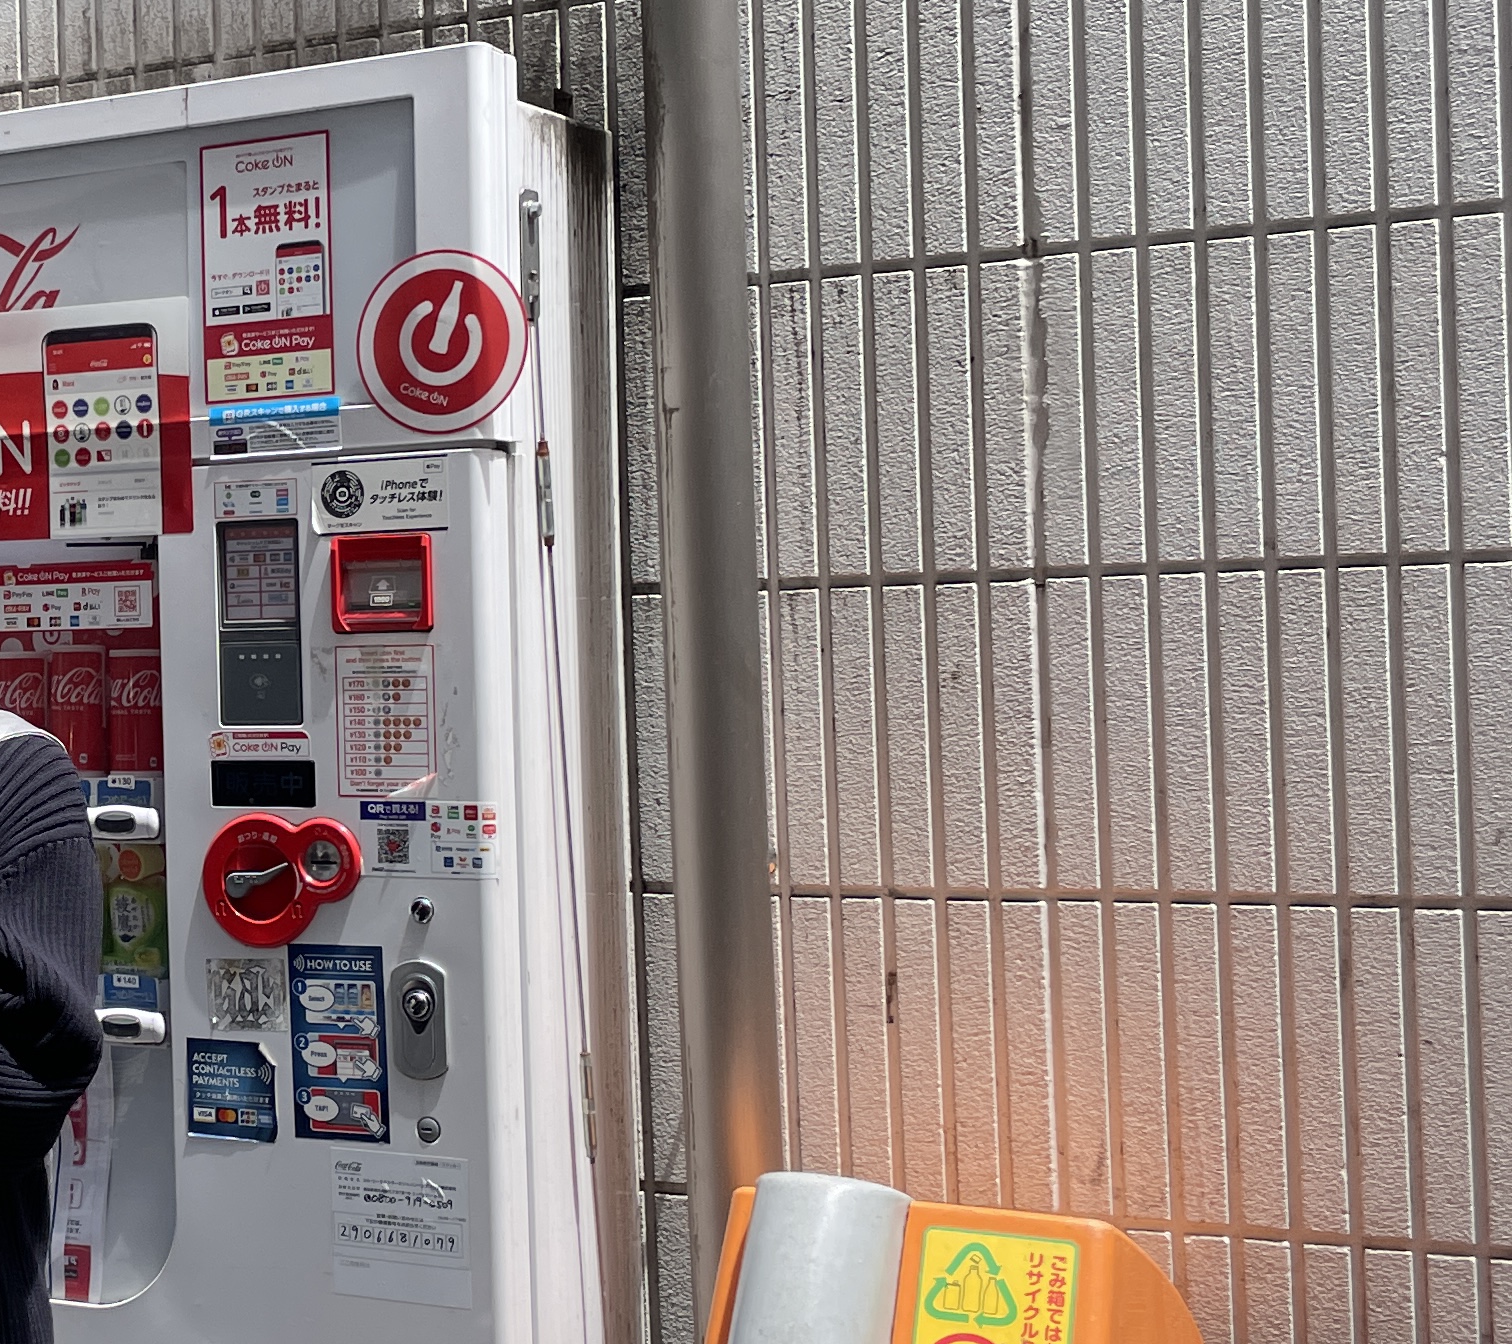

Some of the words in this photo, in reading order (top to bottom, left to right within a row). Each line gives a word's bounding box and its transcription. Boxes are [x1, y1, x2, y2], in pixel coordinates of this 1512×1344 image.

[235, 159, 270, 173] Coke
[272, 153, 294, 169] ON
[252, 180, 320, 198] スタンプたまると
[241, 339, 271, 351] Coke
[272, 336, 291, 348] ON
[291, 336, 315, 349] Pay
[399, 382, 429, 400] Coke
[430, 389, 449, 407] ON
[380, 478, 429, 491] iPhoneで
[369, 490, 443, 505] タッチレス体験!
[17, 572, 38, 582] Coke
[39, 570, 52, 581] ON
[53, 570, 69, 582] Pay
[11, 591, 33, 599] PayPay
[88, 587, 101, 596] Pay
[51, 603, 62, 612] Pay
[349, 680, 365, 688] ¥170
[349, 706, 366, 714] ¥150
[349, 718, 366, 726] ¥140
[350, 730, 366, 738] ¥130
[232, 742, 260, 753] Coke
[261, 741, 278, 753] ON
[280, 742, 301, 754] Pay
[350, 743, 367, 751] ¥120
[350, 756, 367, 764] ¥110
[307, 959, 334, 970] HOW
[335, 959, 350, 970] TO
[351, 960, 373, 971] USE
[297, 982, 302, 992] 1
[299, 1037, 306, 1047] 2
[192, 1052, 228, 1063] ACCEPT
[192, 1063, 257, 1077] CONTACTLESS
[192, 1075, 239, 1087] PAYMENTS
[301, 1091, 308, 1100] 3
[197, 1110, 213, 1118] VISA
[335, 1160, 362, 1172] Coca-Cola
